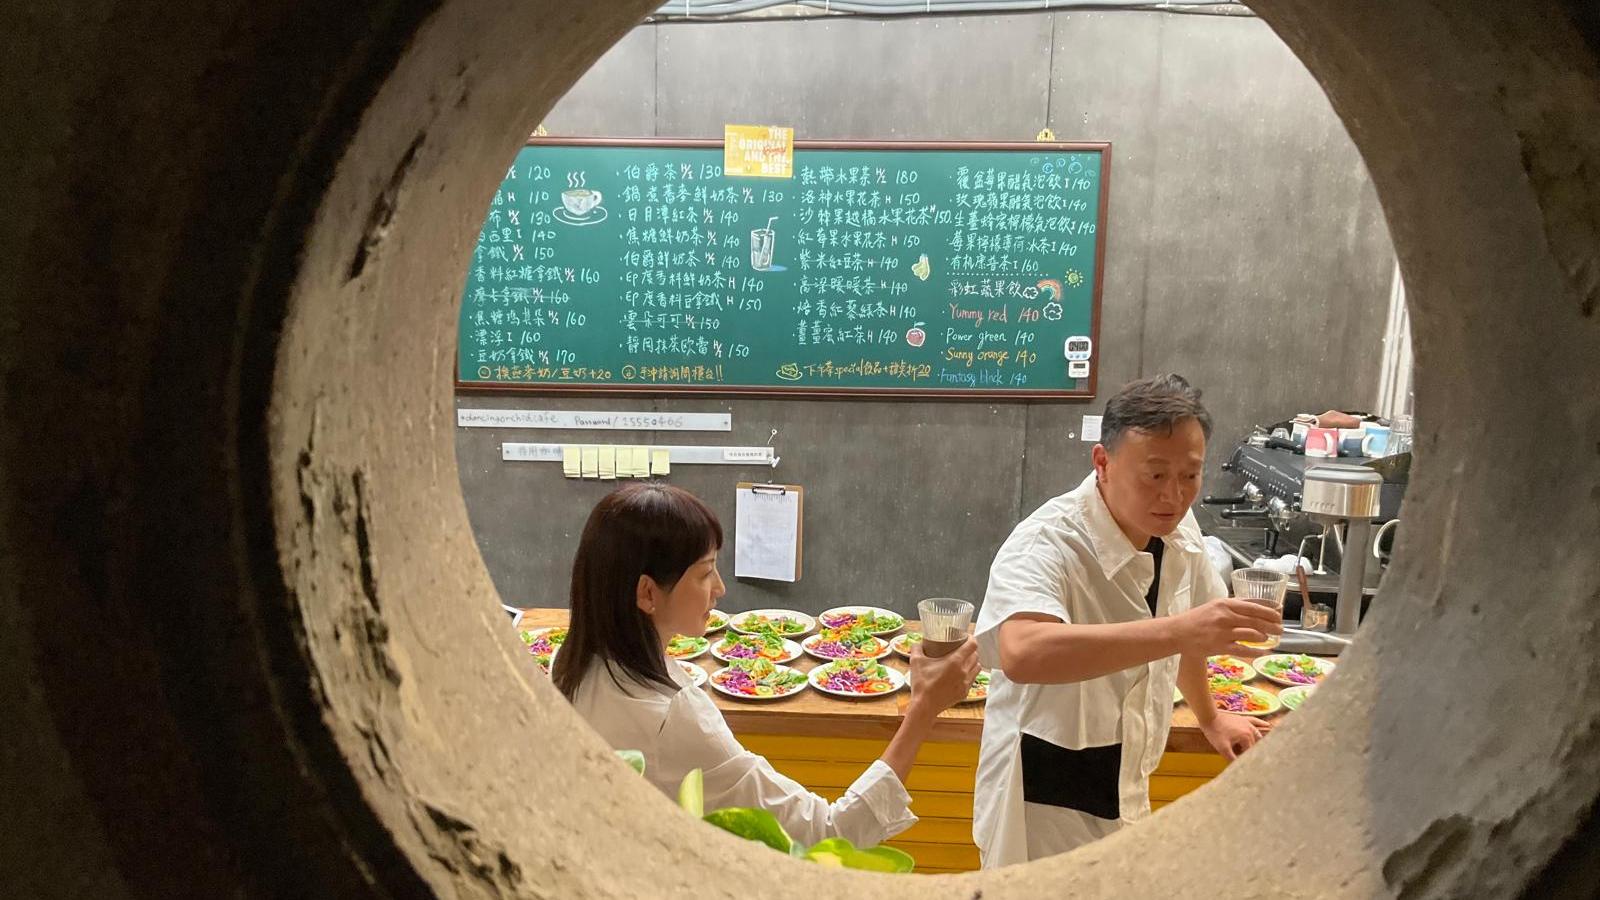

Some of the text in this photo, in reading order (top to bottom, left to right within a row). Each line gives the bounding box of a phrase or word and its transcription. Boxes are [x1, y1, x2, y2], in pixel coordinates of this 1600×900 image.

[528, 166, 550, 181] 120
[624, 163, 677, 181] 伯爵茶
[700, 164, 721, 180] 130
[896, 169, 918, 185] 180
[1072, 178, 1090, 190] 140
[508, 192, 516, 202] H
[529, 192, 549, 205] 110
[763, 190, 784, 202] 130
[885, 195, 891, 203] H
[899, 192, 920, 206] 150
[1068, 200, 1087, 211] 140
[530, 211, 550, 225] 130
[720, 210, 739, 226] 140
[1078, 223, 1096, 235] 140
[532, 230, 556, 243] 140
[723, 236, 740, 248] 140
[891, 235, 898, 246] H
[903, 236, 920, 248] 150
[534, 247, 554, 260] 150
[1058, 241, 1077, 257] 140
[722, 256, 740, 270] 140
[880, 257, 898, 271] 140
[1021, 259, 1039, 273] 160
[581, 267, 600, 284] 160
[728, 276, 736, 289] H
[742, 276, 764, 292] 140
[890, 282, 908, 296] 140
[550, 290, 569, 305] 160
[726, 296, 733, 305] H
[739, 299, 762, 311] 150
[890, 306, 896, 317] H
[899, 305, 916, 318] 140
[949, 303, 1039, 327] Yummy red 140
[566, 311, 586, 328] 160
[700, 316, 720, 329] 150
[521, 330, 541, 345] 160
[867, 330, 873, 343] H
[878, 329, 897, 345] 140
[946, 328, 1034, 349] Power green 140
[556, 349, 576, 365] 170
[728, 343, 750, 358] 150
[945, 347, 1036, 367] Sunny orange 140
[1009, 373, 1027, 386] 140
